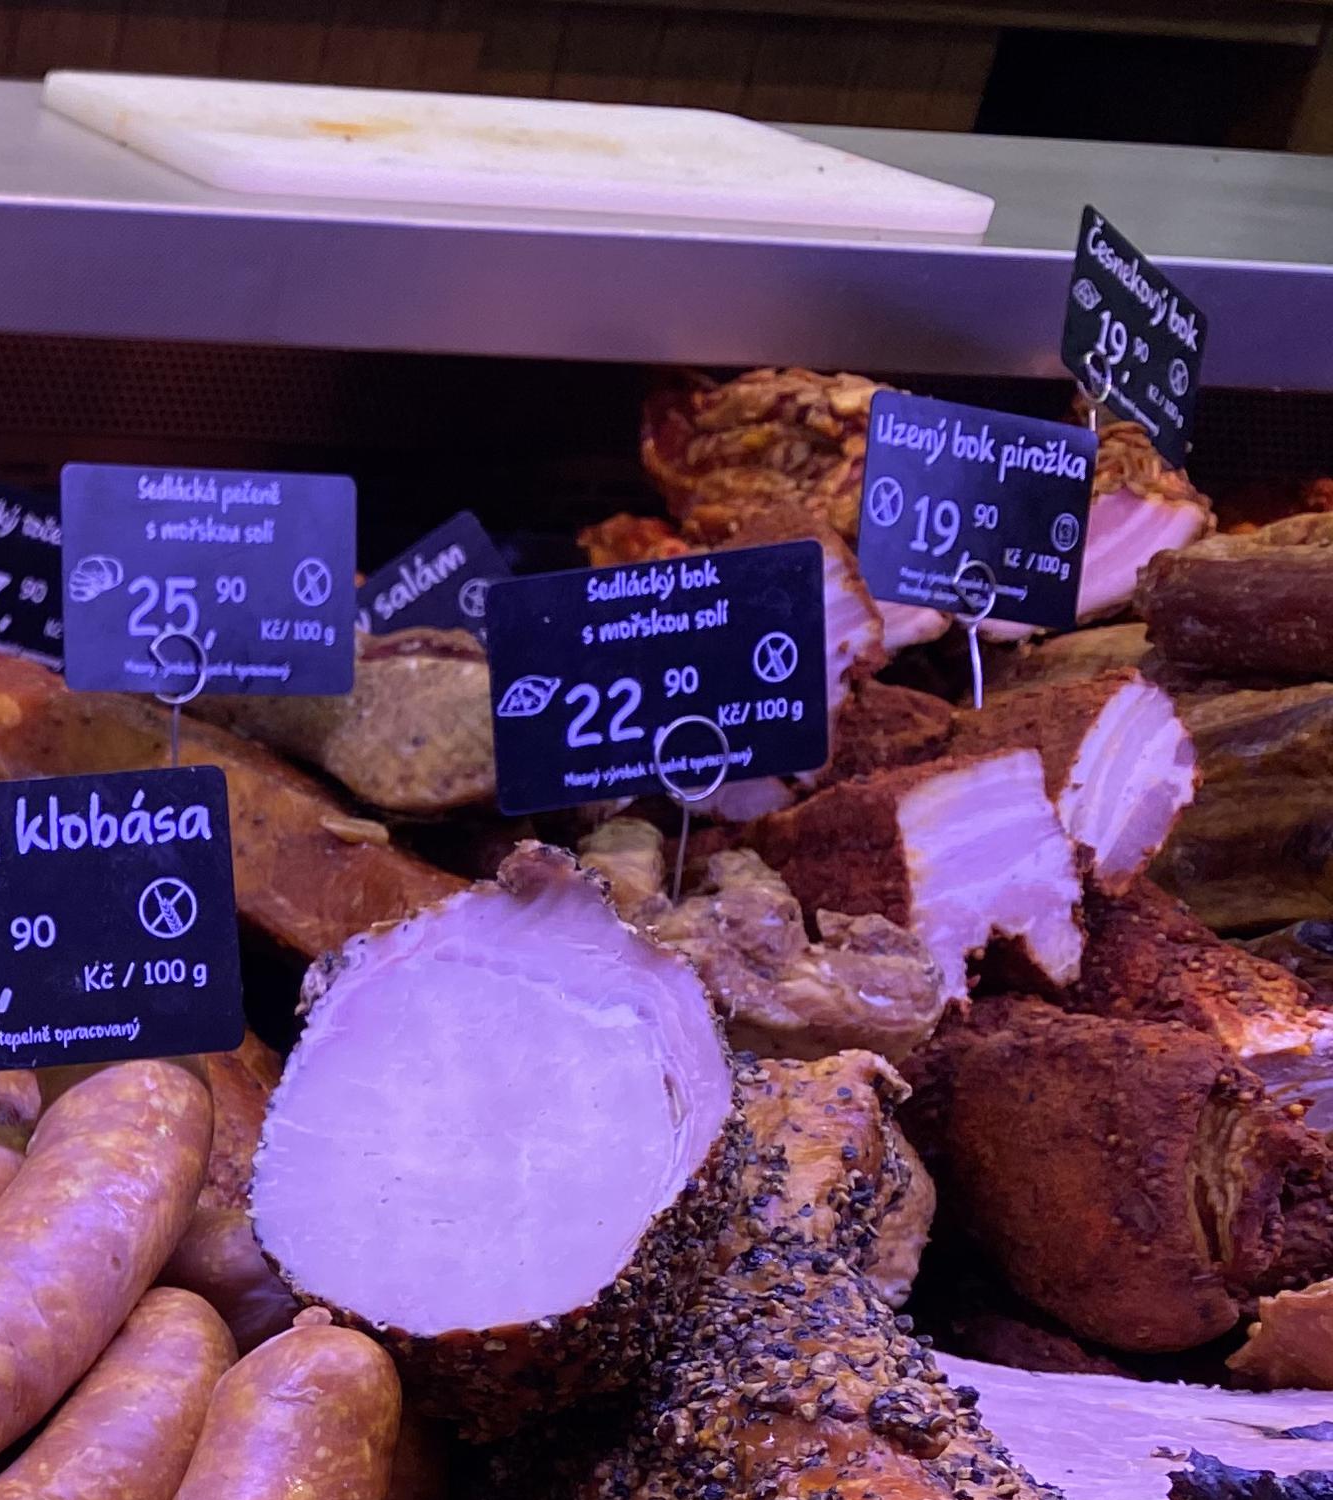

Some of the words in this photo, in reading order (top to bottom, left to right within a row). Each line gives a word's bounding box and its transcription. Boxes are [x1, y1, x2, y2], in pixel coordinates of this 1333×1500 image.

[1168, 296, 1198, 352] bok
[877, 413, 947, 466] Uzený
[952, 420, 995, 464] bok
[998, 436, 1087, 483] pirožka
[221, 480, 281, 514] pečeně
[146, 520, 156, 540] s
[161, 514, 241, 543] mořskou
[973, 504, 999, 530] 90
[373, 544, 466, 620] salám
[587, 564, 675, 603] Sedlácký
[680, 559, 720, 590] bok
[1059, 563, 1071, 581] g
[19, 576, 48, 604] 90
[216, 576, 247, 604] 90
[294, 620, 321, 641] 100
[323, 625, 335, 646] g
[581, 626, 594, 645] s
[600, 608, 689, 643] mořskou
[664, 666, 699, 698] 90
[756, 698, 788, 722] 100
[791, 699, 803, 722] g
[15, 789, 212, 856] klobása
[10, 914, 56, 951] 90
[83, 963, 114, 992] Kč
[143, 959, 186, 985] 100
[191, 963, 207, 987] g
[55, 1017, 140, 1048] opracovaný
